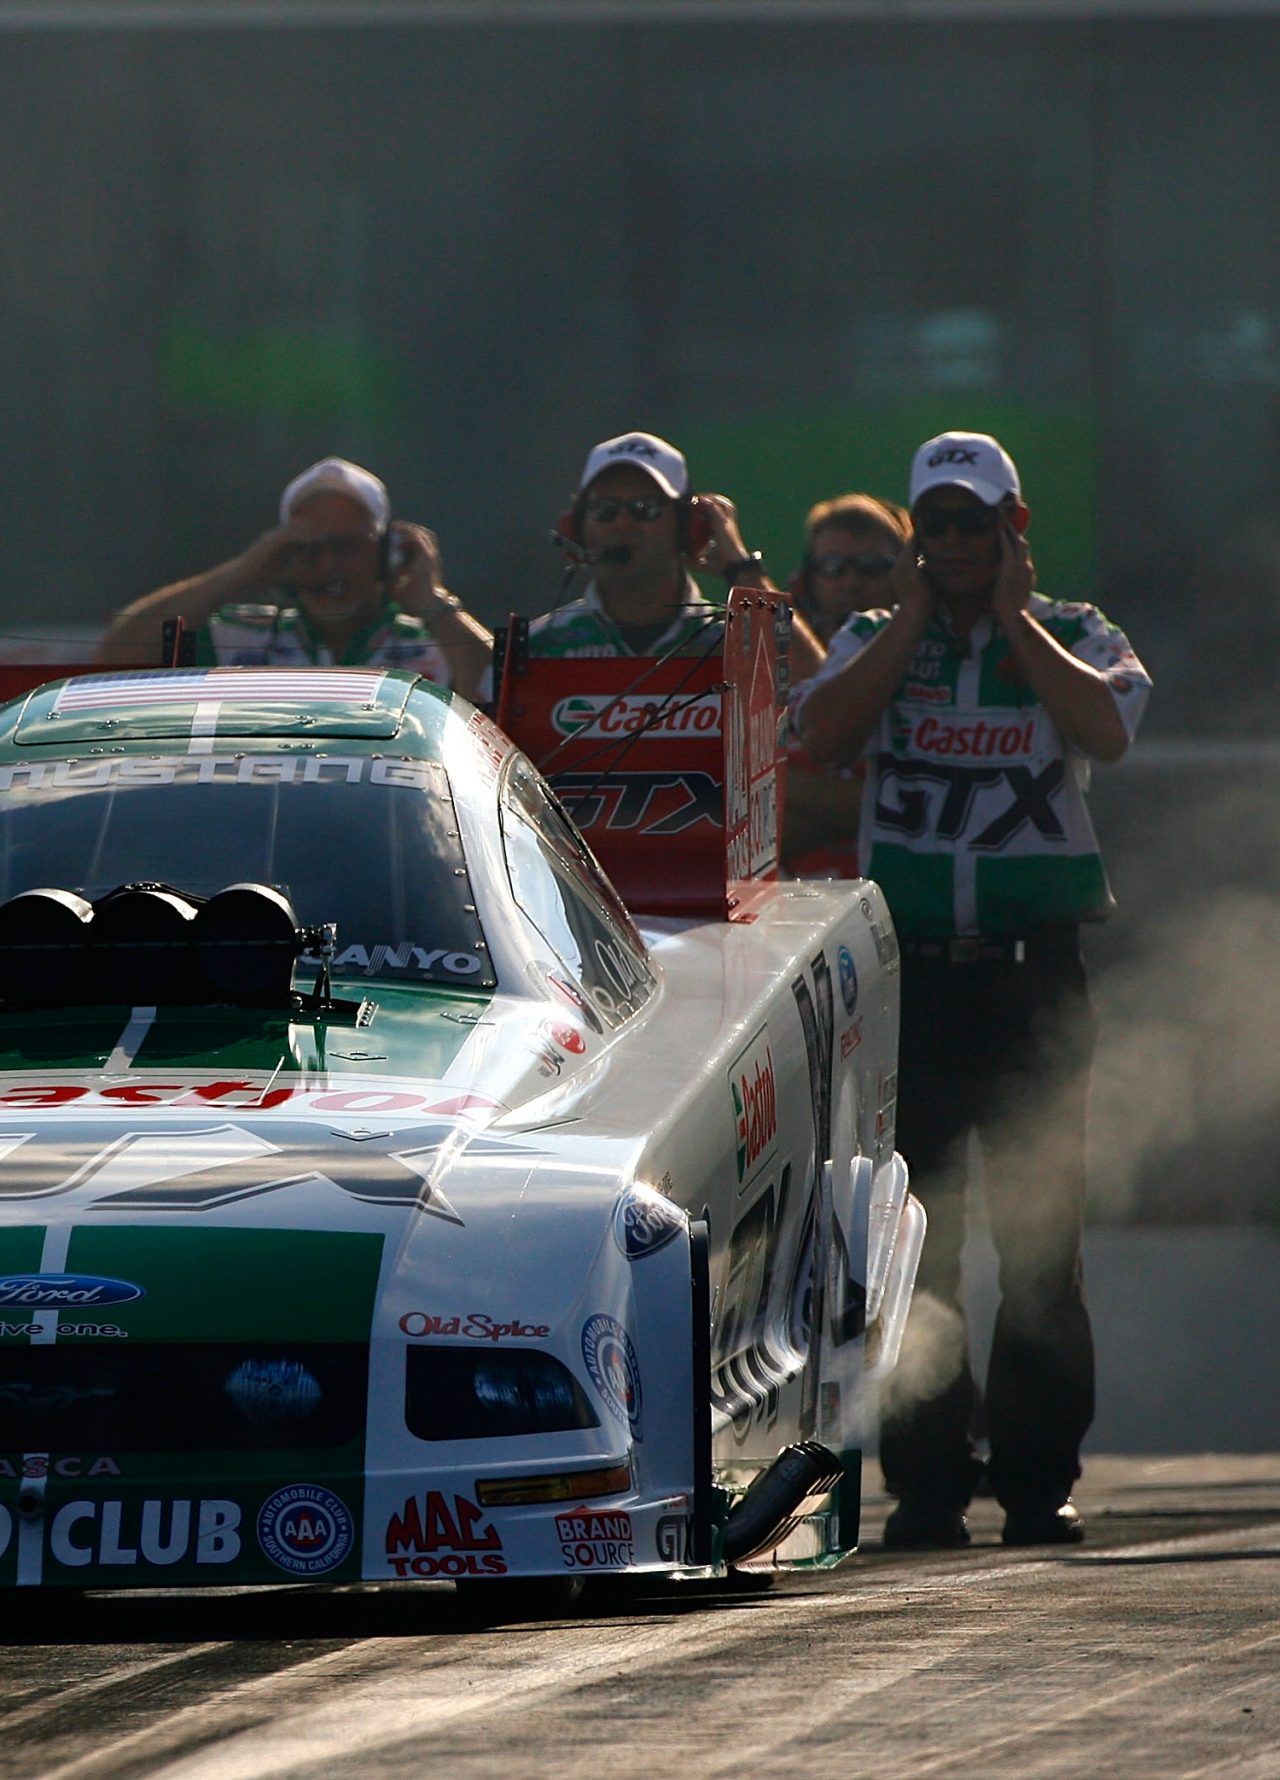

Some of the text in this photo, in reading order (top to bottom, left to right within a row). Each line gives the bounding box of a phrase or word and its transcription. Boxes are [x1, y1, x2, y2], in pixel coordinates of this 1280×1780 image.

[928, 448, 980, 468] GTX
[599, 698, 722, 732] Castro
[914, 718, 1037, 756] Castrol
[873, 753, 1069, 851] GTX
[741, 1046, 777, 1169] Castrol
[56, 1323, 129, 1338] one.
[399, 1311, 551, 1341] Old Spice
[263, 1488, 348, 1526] AUTOMOBILE CLUB
[385, 1490, 503, 1554] MAC
[49, 1499, 242, 1568] CLUB
[284, 1519, 328, 1541] AAA
[559, 1515, 632, 1541] BRAND
[263, 1532, 350, 1571] SOUTHERN CALIFORNIA
[387, 1554, 508, 1577] TOOLS
[563, 1542, 635, 1568] SOURCE
